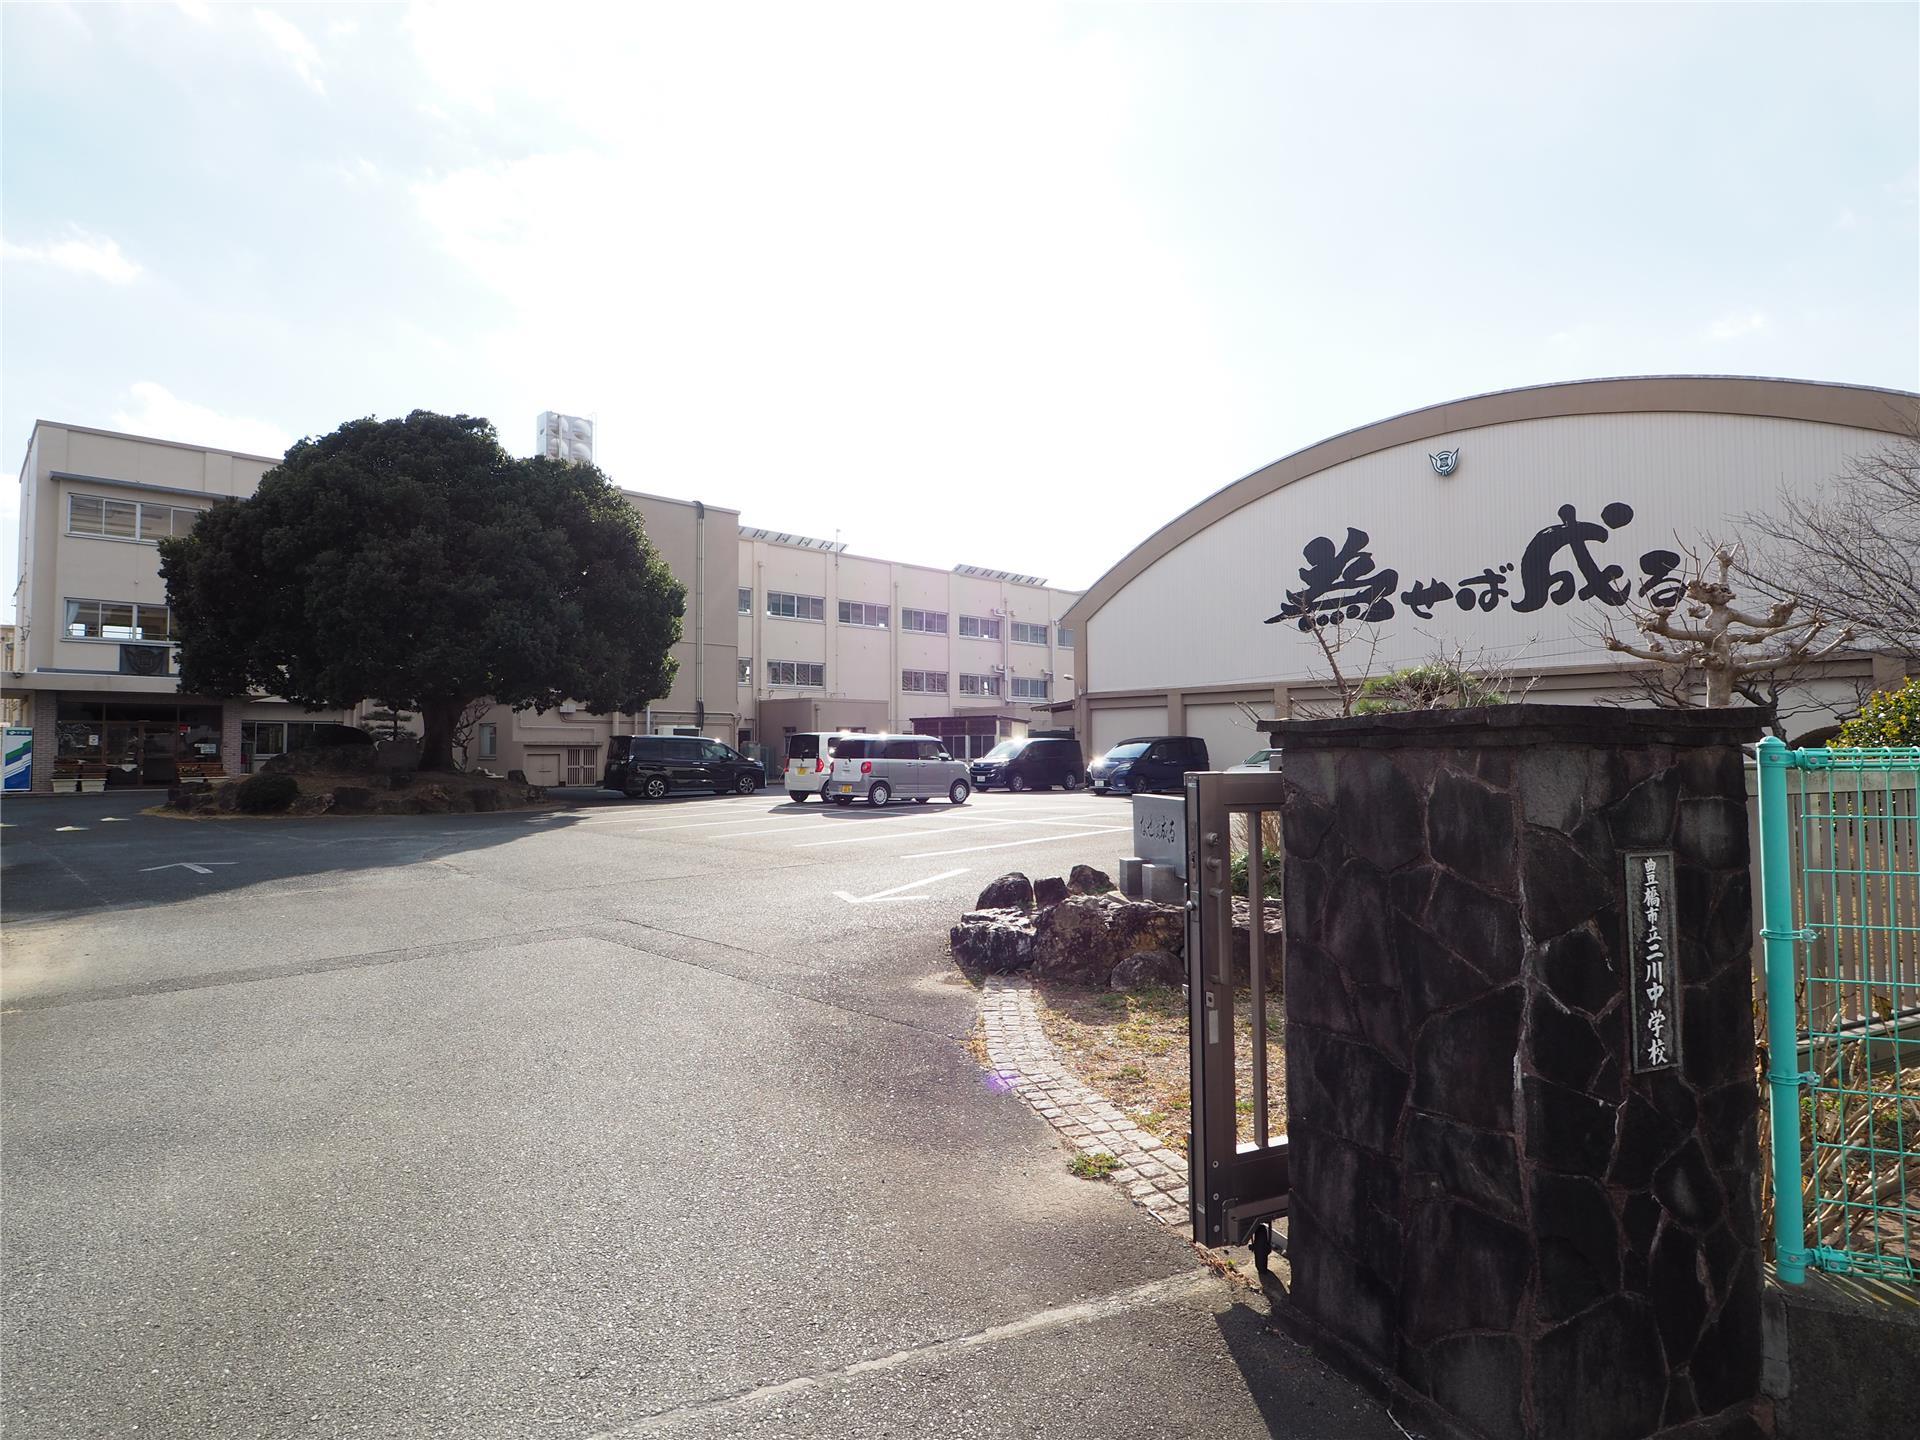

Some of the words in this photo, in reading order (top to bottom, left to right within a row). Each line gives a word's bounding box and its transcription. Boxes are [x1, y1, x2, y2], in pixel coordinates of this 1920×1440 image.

[1264, 503, 1689, 632] 為せば成る
[1643, 857, 1669, 1066] 豊橋市立二川中学校
